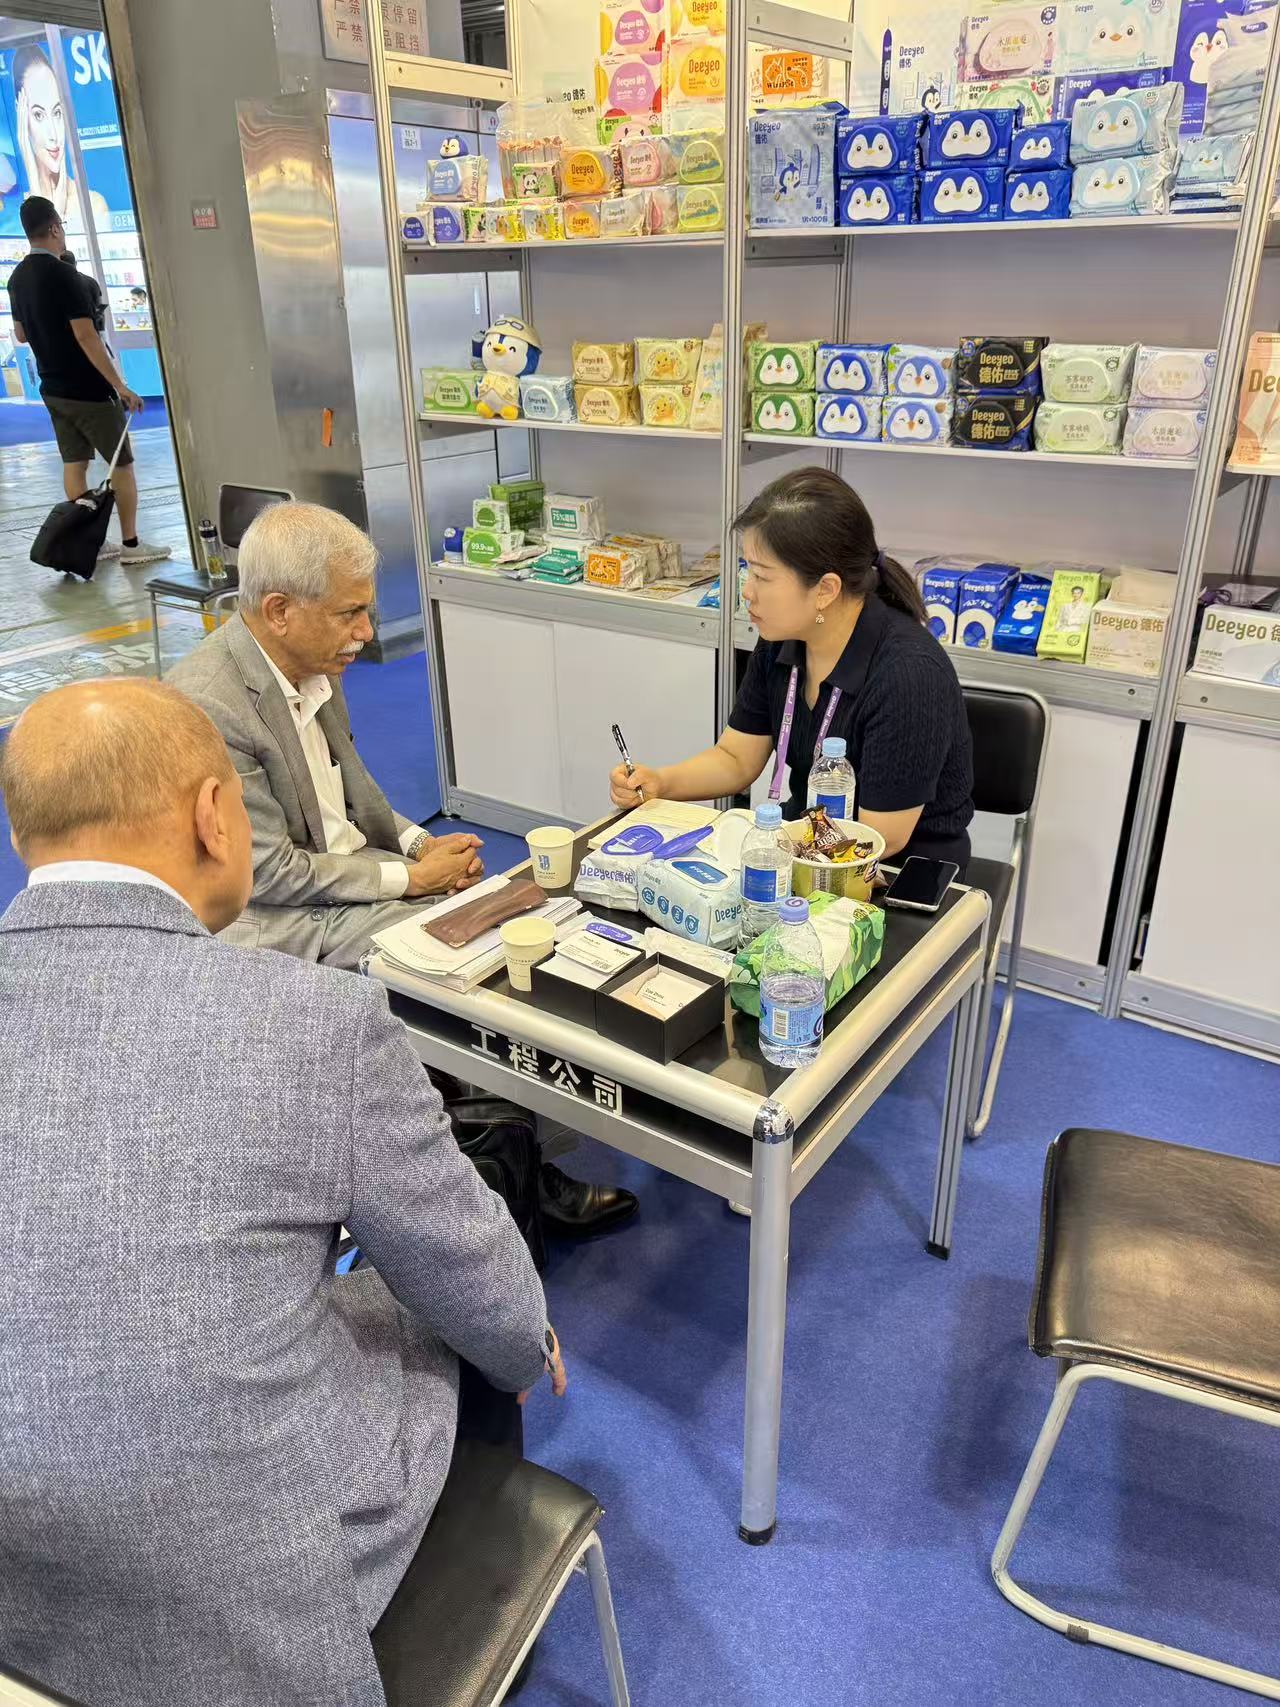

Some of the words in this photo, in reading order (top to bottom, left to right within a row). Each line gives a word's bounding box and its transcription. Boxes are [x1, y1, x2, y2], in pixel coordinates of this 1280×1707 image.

[899, 46, 925, 57] Deeyeo
[688, 59, 721, 76] Deeyeo
[754, 122, 782, 134] Deeyeo
[571, 164, 595, 176] Deeyeo
[980, 353, 1014, 367] Deeyeo
[979, 366, 1004, 384] 德佑
[971, 409, 1005, 423] Deeyeo
[971, 423, 996, 440] 德佑
[925, 577, 945, 589] Deeyeo
[964, 582, 985, 593] Deeyeo
[1093, 611, 1138, 632] Deeyeo
[1140, 618, 1165, 633] 德佑
[1205, 613, 1267, 640] Deeyeo
[714, 904, 743, 923] Deeye
[471, 1024, 624, 1116] 工程公司
